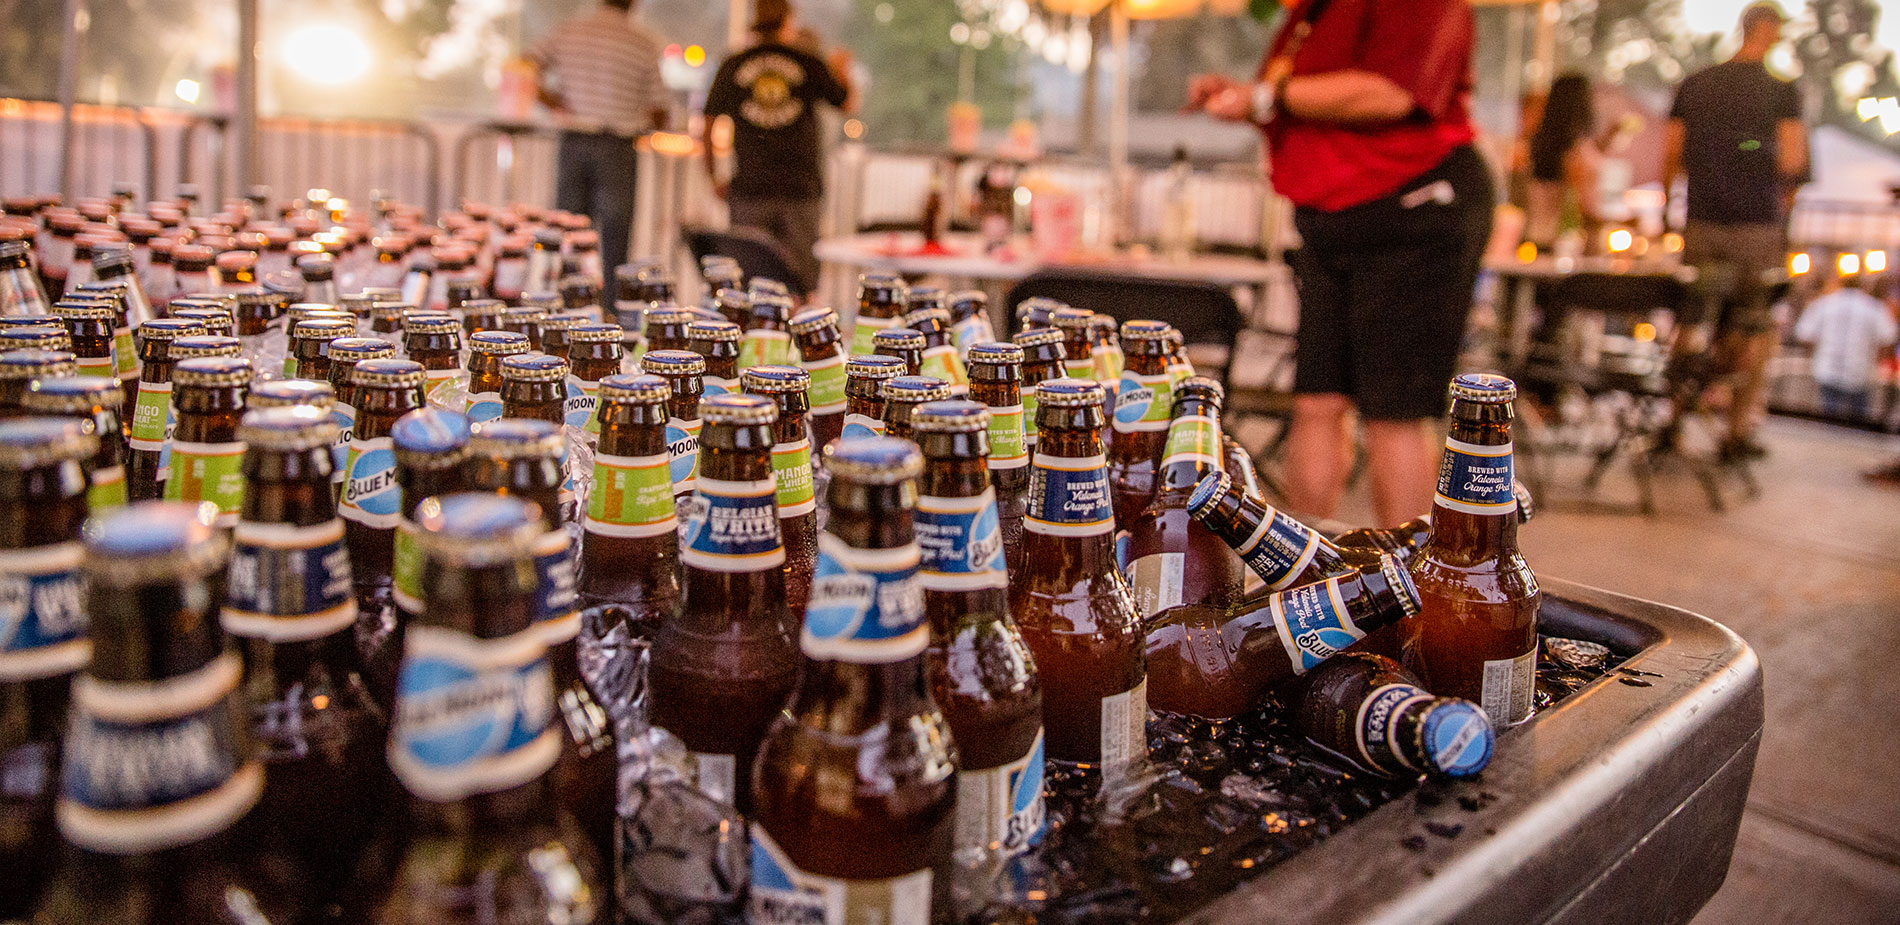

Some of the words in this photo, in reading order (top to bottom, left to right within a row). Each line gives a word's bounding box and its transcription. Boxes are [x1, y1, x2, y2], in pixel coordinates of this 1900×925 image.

[566, 397, 596, 412] MOON
[667, 437, 700, 457] MOON
[775, 463, 811, 480] MANGO
[1467, 466, 1495, 475] BREWED
[1495, 466, 1508, 474] WITH
[784, 476, 808, 488] WHEAT
[1472, 474, 1504, 484] Valencia
[347, 476, 381, 501] BLUE
[1463, 481, 1493, 497] Orange
[1495, 483, 1511, 493] Peel
[1063, 500, 1095, 516] Orange
[711, 517, 775, 534] WHITE
[973, 535, 999, 568] BLU
[1295, 609, 1310, 629] Peel
